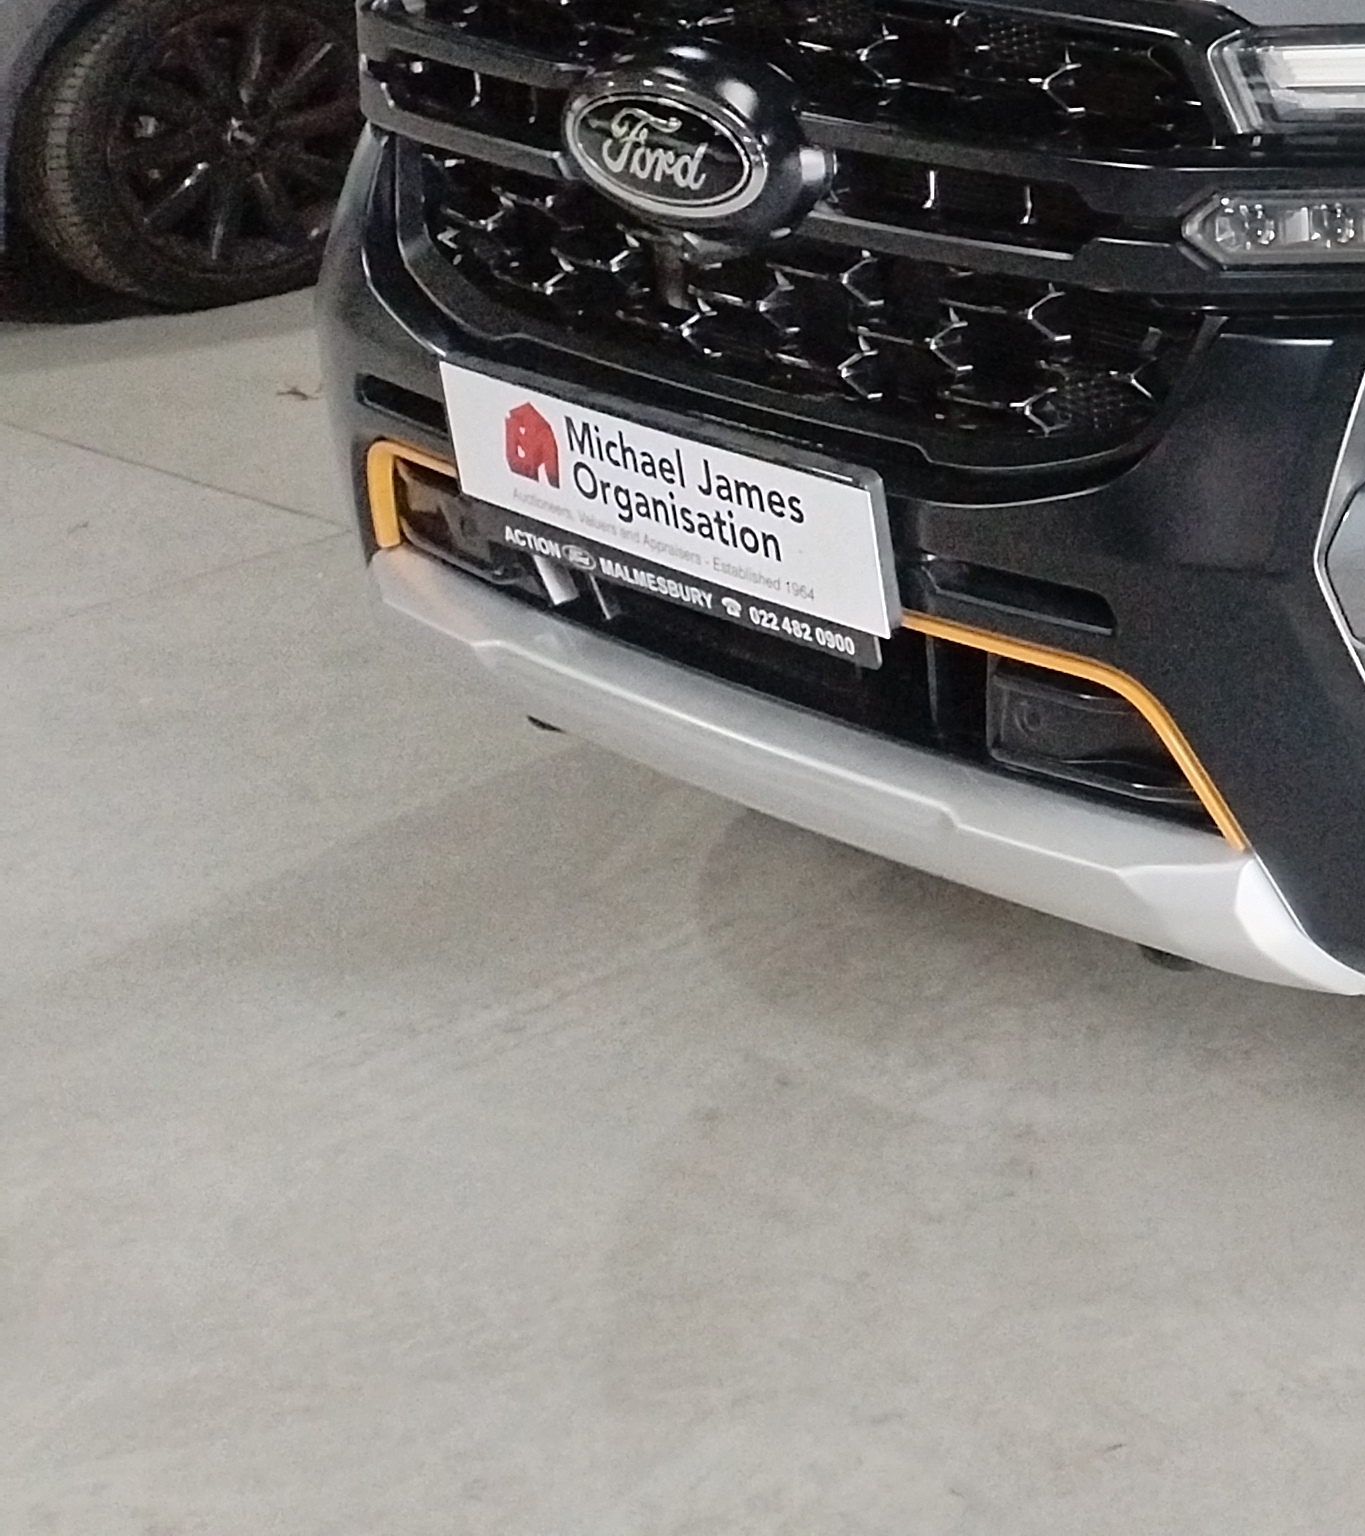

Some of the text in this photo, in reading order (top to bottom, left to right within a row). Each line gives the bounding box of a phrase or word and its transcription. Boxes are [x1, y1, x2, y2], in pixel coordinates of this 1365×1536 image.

[601, 107, 708, 191] Ford
[564, 415, 805, 524] Michael James
[573, 461, 782, 562] Organisation
[505, 525, 561, 559] ACTION
[600, 556, 713, 610] MALMESBURY
[749, 606, 856, 656] 022 482 0900
